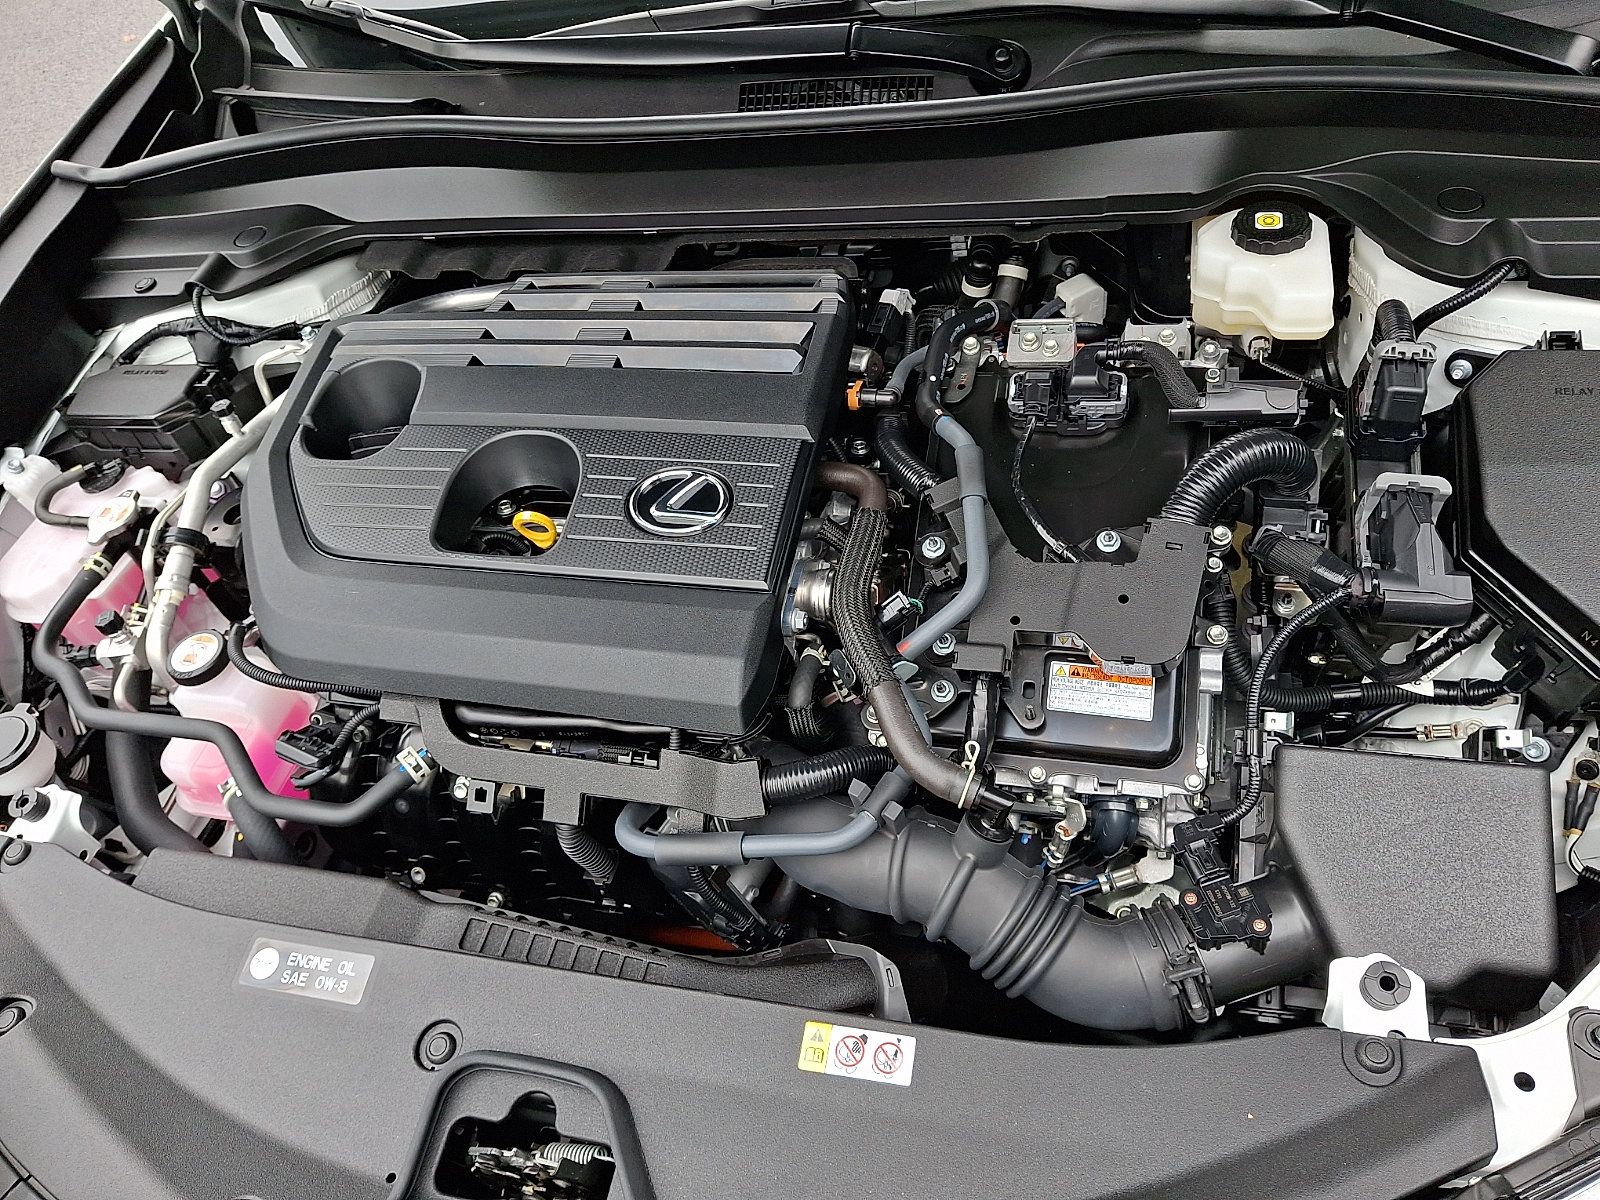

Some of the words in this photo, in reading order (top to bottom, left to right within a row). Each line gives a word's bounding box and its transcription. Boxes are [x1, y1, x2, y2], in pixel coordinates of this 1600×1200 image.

[1554, 387, 1594, 396] RELAY
[287, 952, 333, 972] ENGINE
[337, 960, 356, 976] OIL
[280, 969, 310, 987] SAE
